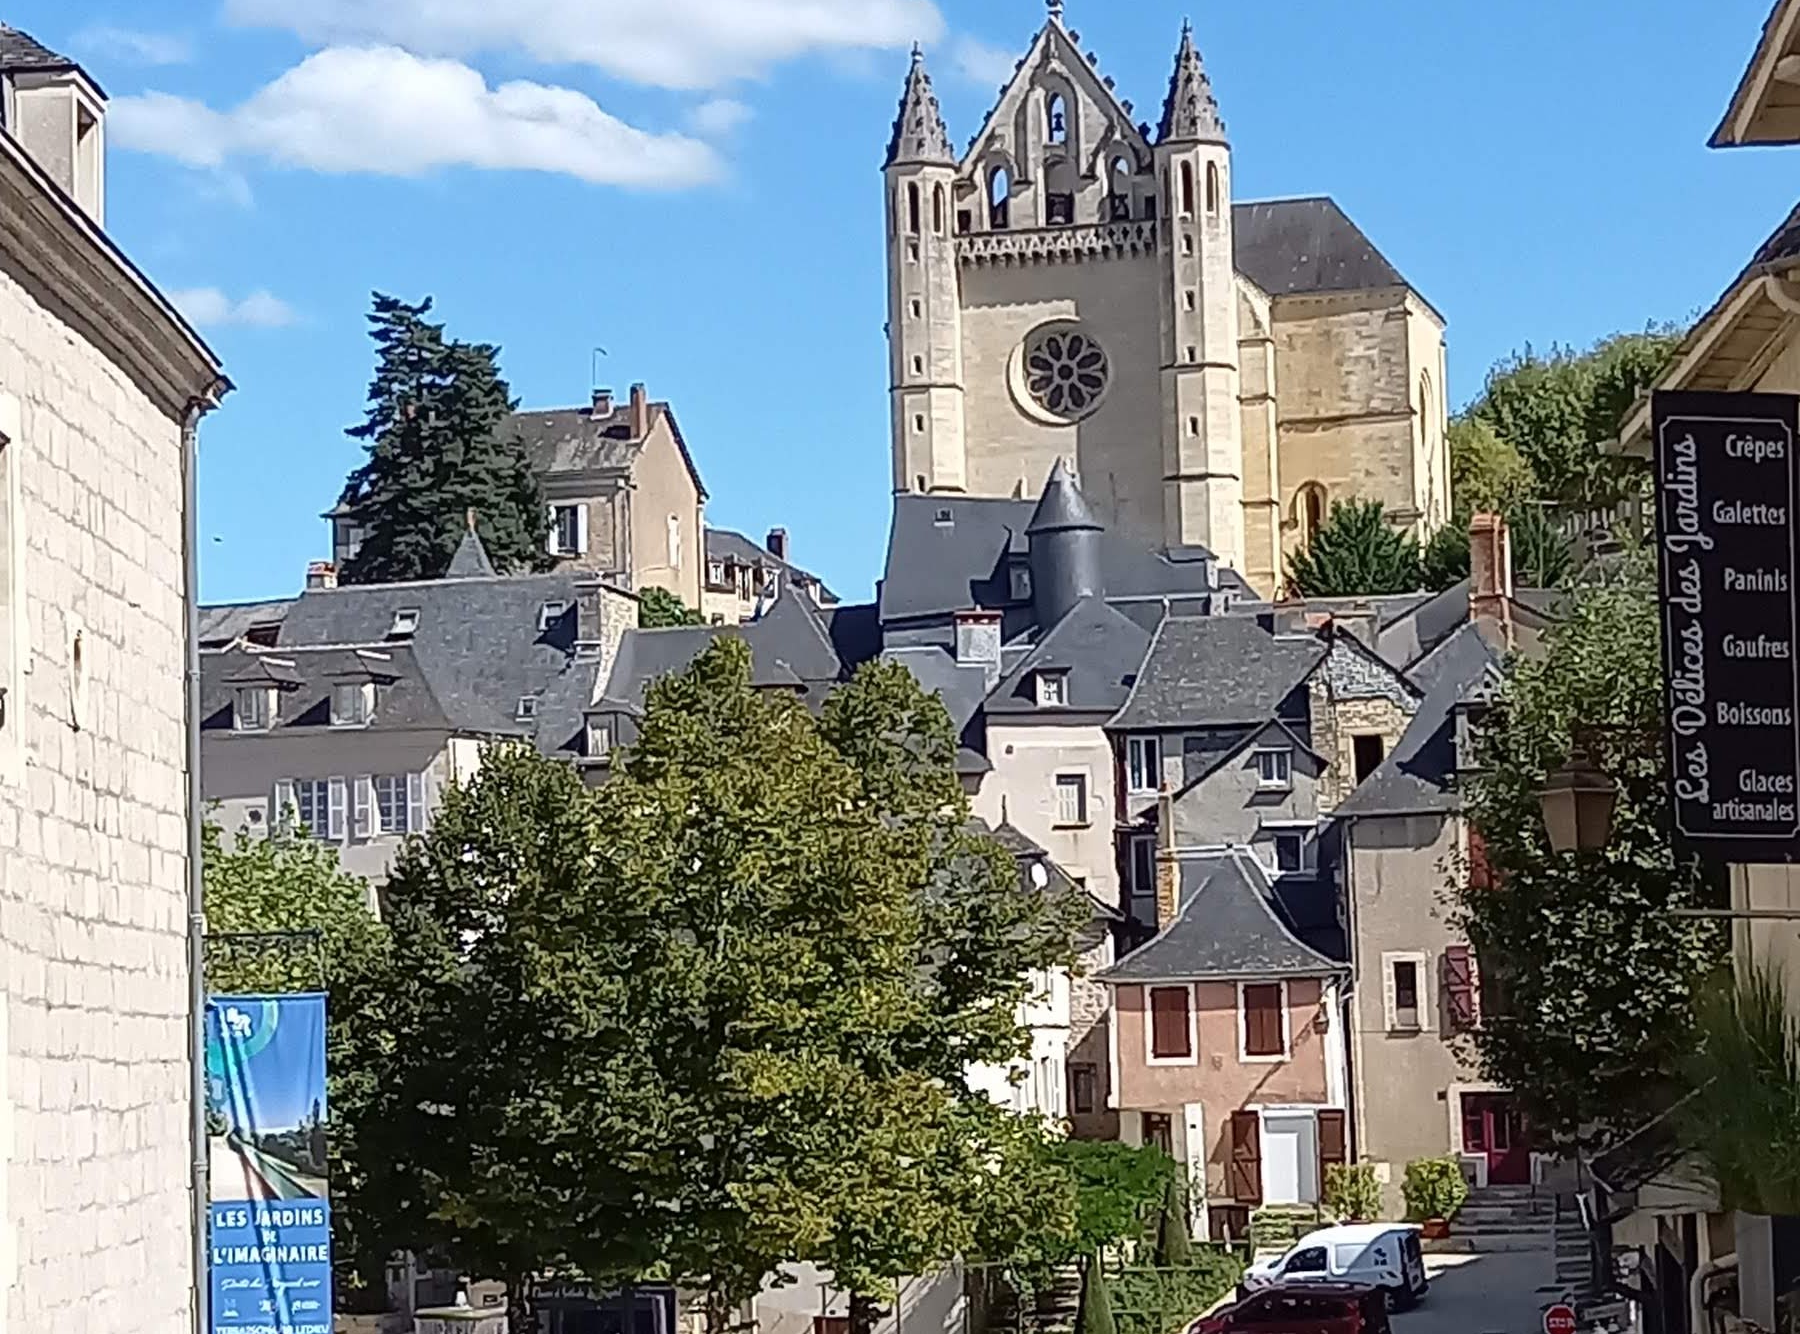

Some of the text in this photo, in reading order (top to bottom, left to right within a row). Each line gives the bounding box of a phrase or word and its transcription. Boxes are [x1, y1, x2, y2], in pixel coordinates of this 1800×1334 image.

[1725, 434, 1784, 463] Crêpes
[1712, 499, 1785, 525] Galettes
[1723, 567, 1788, 591] Paninis
[1664, 433, 1714, 803] Les Délices des Jardins
[1722, 634, 1790, 658] Gaufres
[1716, 701, 1791, 726] Boissons
[1739, 768, 1794, 792] Glaces
[1712, 797, 1795, 821] artisanales
[215, 1208, 323, 1228] LES JARDINS
[212, 1244, 328, 1265] L'IMAGINAIRE
